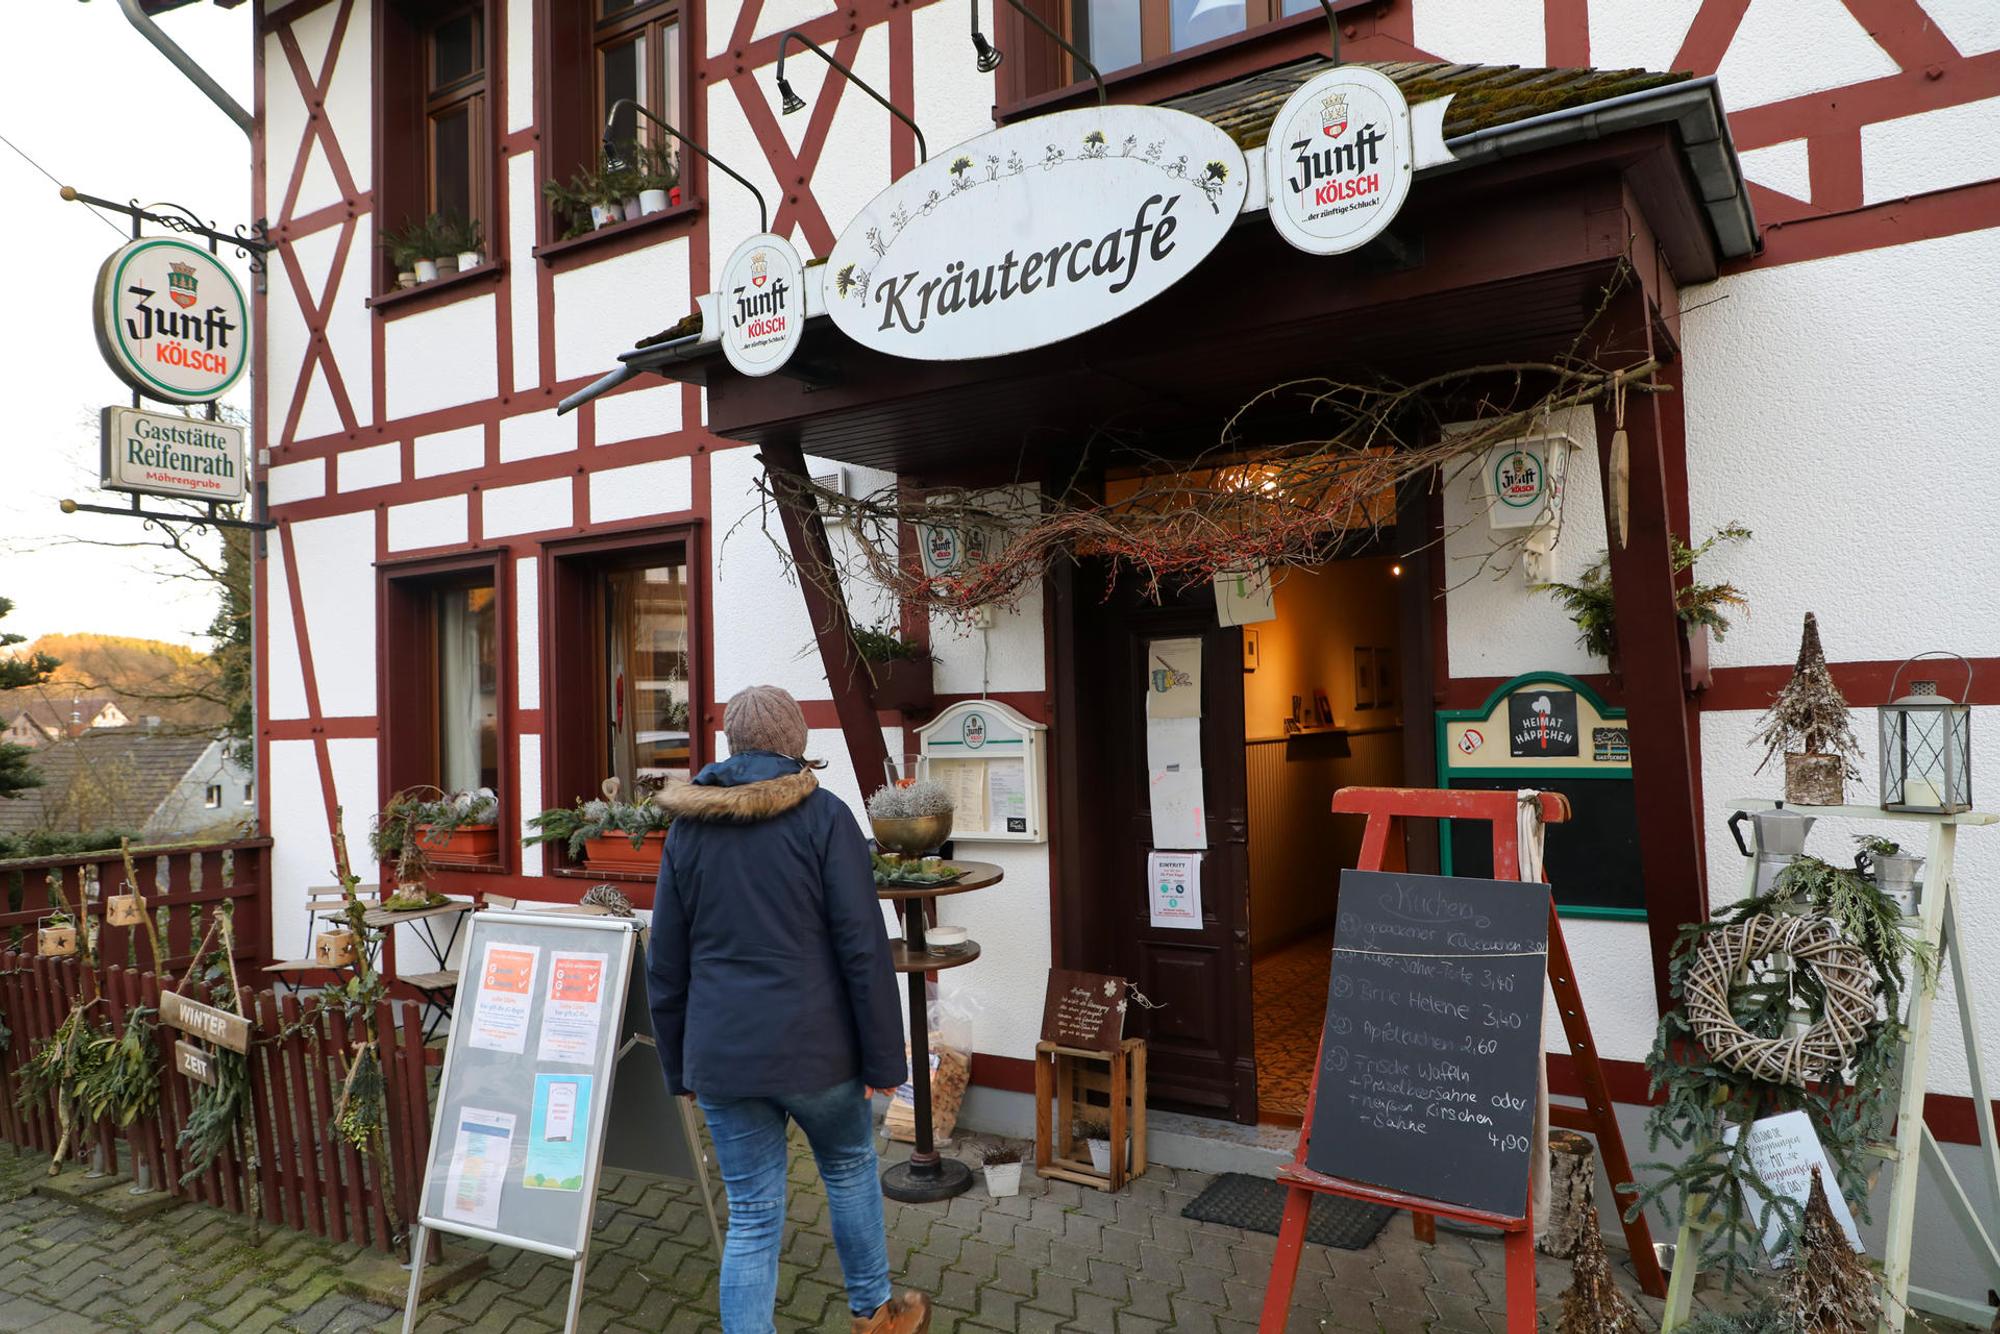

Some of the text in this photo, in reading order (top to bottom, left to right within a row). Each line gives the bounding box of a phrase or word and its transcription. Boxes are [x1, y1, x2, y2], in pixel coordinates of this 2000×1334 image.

[1288, 121, 1387, 194] Zunft
[1315, 173, 1379, 206] KÖLSCH
[1320, 205, 1348, 219] zünftige
[1349, 197, 1380, 212] Schluck!
[875, 194, 1181, 334] Kräutercafé
[732, 276, 789, 328] Zunft
[125, 284, 237, 352] Zunft
[747, 316, 785, 338] KÖLSCH
[156, 341, 227, 375] KÖLSCH
[134, 418, 227, 450] Gaststätte
[127, 438, 235, 478] Reifenrath
[145, 471, 222, 490] Möhrengrube
[1522, 717, 1563, 729] HEIMAT
[1515, 730, 1572, 745] HÄPPCHEN
[1409, 992, 1470, 1020] Helene
[180, 1004, 227, 1038] WINTER
[184, 1052, 207, 1078] ZEIT
[1418, 1061, 1470, 1083] Waffeln
[1491, 1092, 1527, 1111] oder
[1373, 1112, 1429, 1135] Sahne
[1426, 1103, 1493, 1126] Kirschen
[1488, 1131, 1529, 1152] 4,90
[1770, 1152, 1785, 1168] MIT
